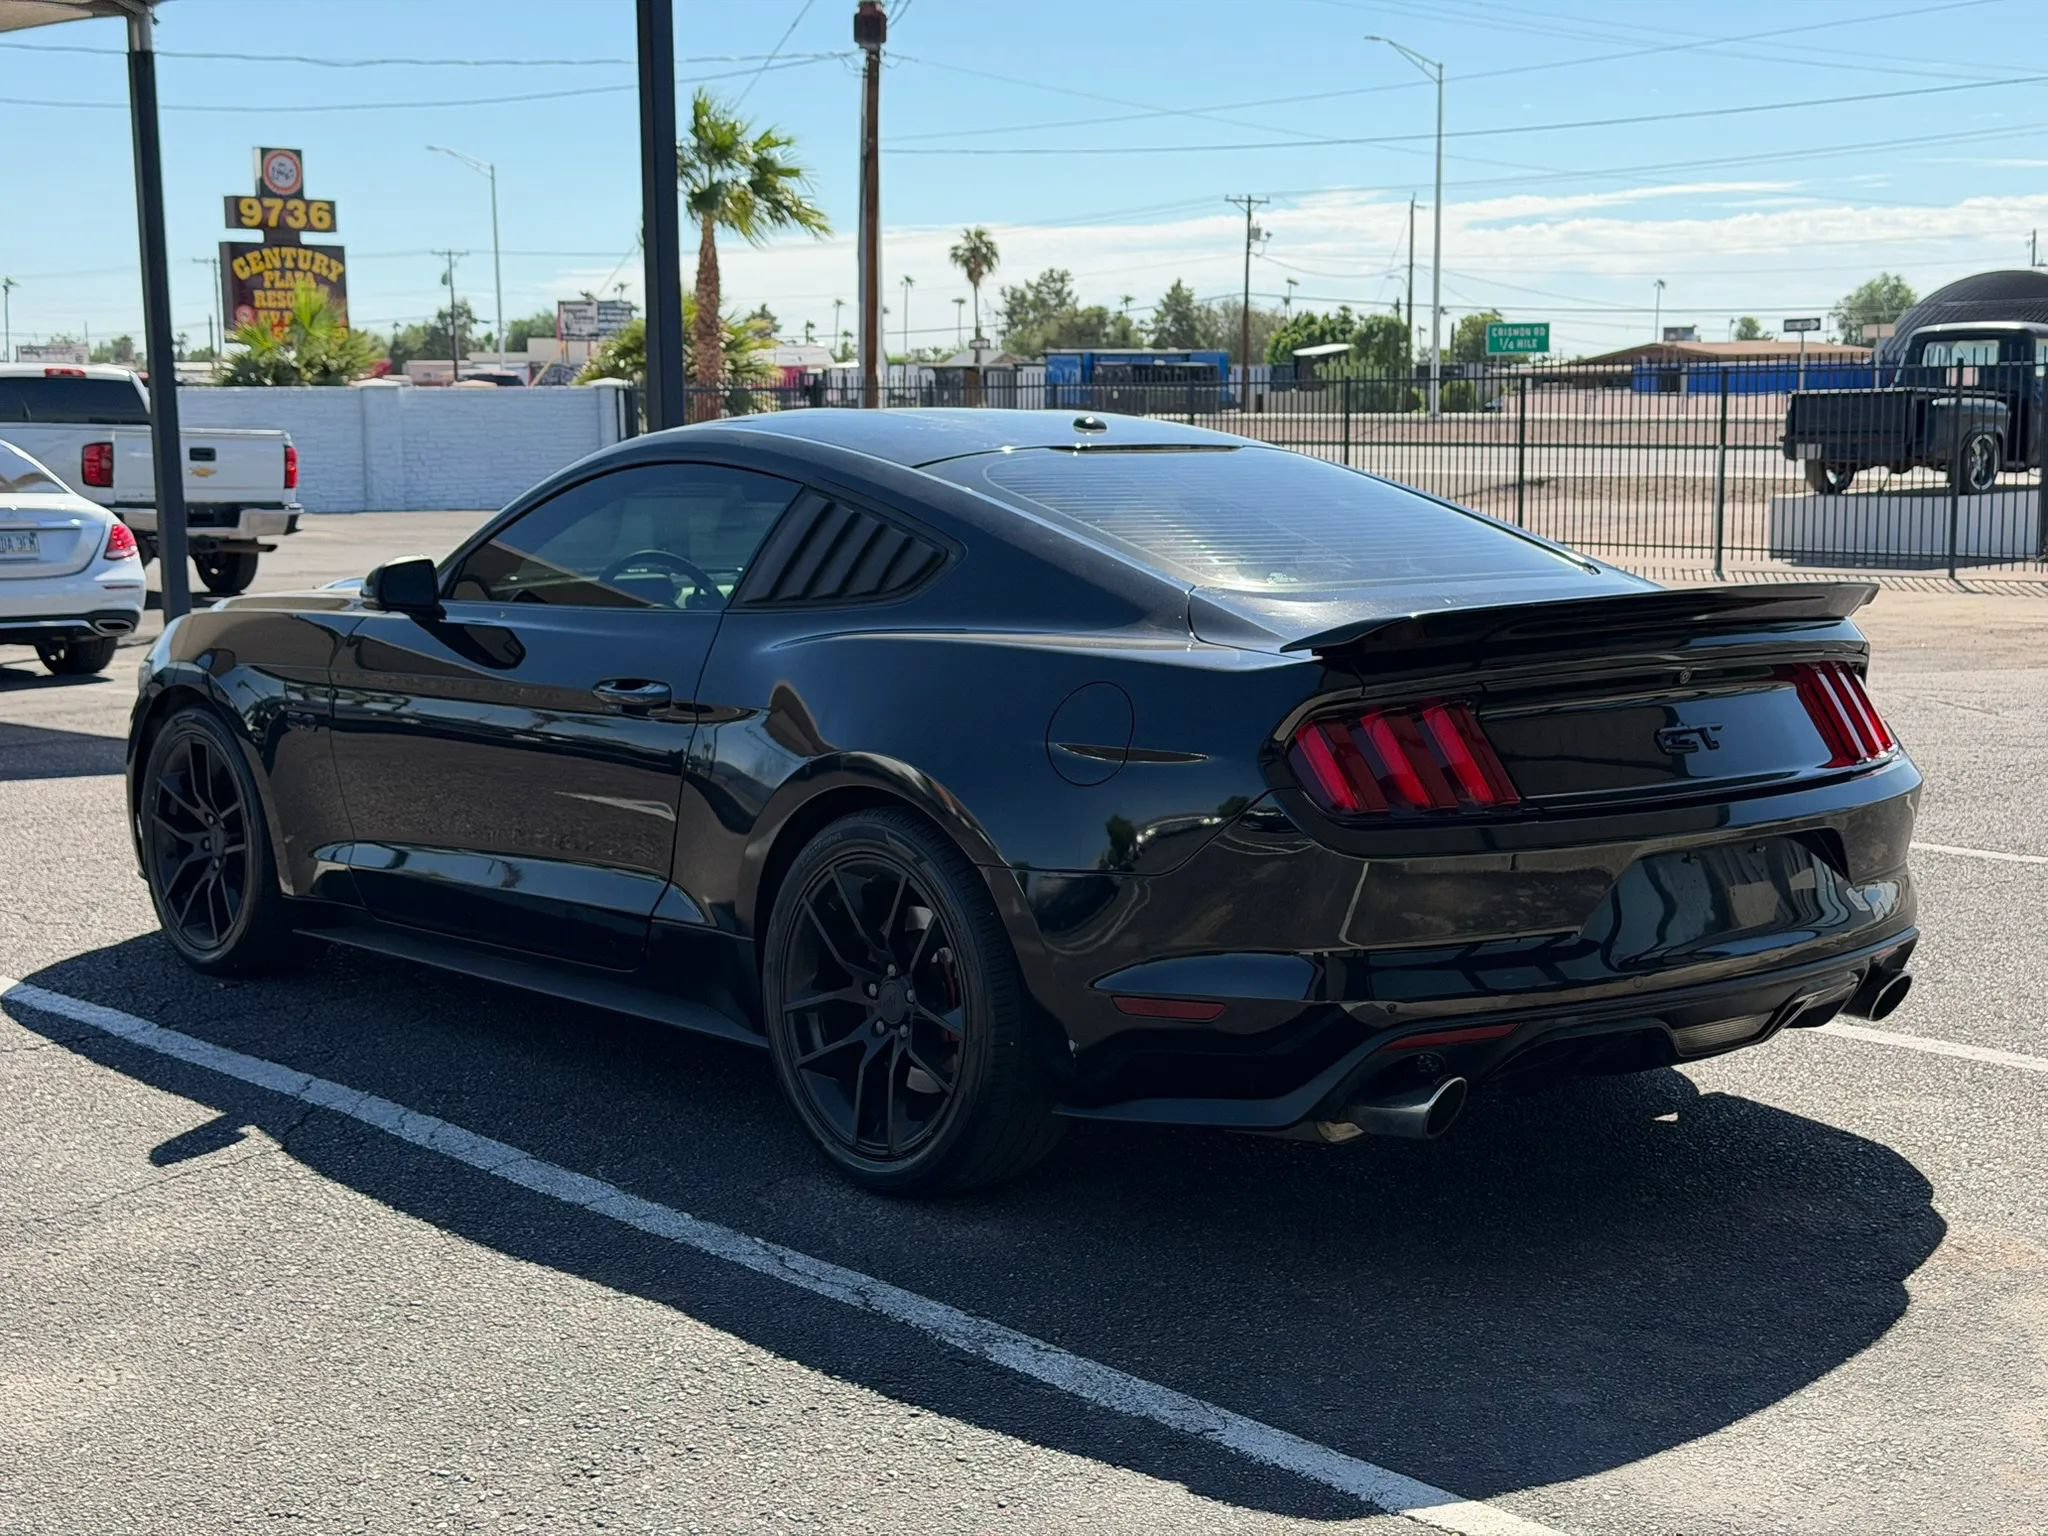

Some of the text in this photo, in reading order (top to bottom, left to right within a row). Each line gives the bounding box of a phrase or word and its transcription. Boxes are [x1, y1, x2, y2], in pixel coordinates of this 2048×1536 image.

[239, 197, 332, 230] 9736
[231, 246, 345, 283] CENTURY
[1516, 339, 1538, 349] MILE
[1653, 724, 1724, 756] GT
